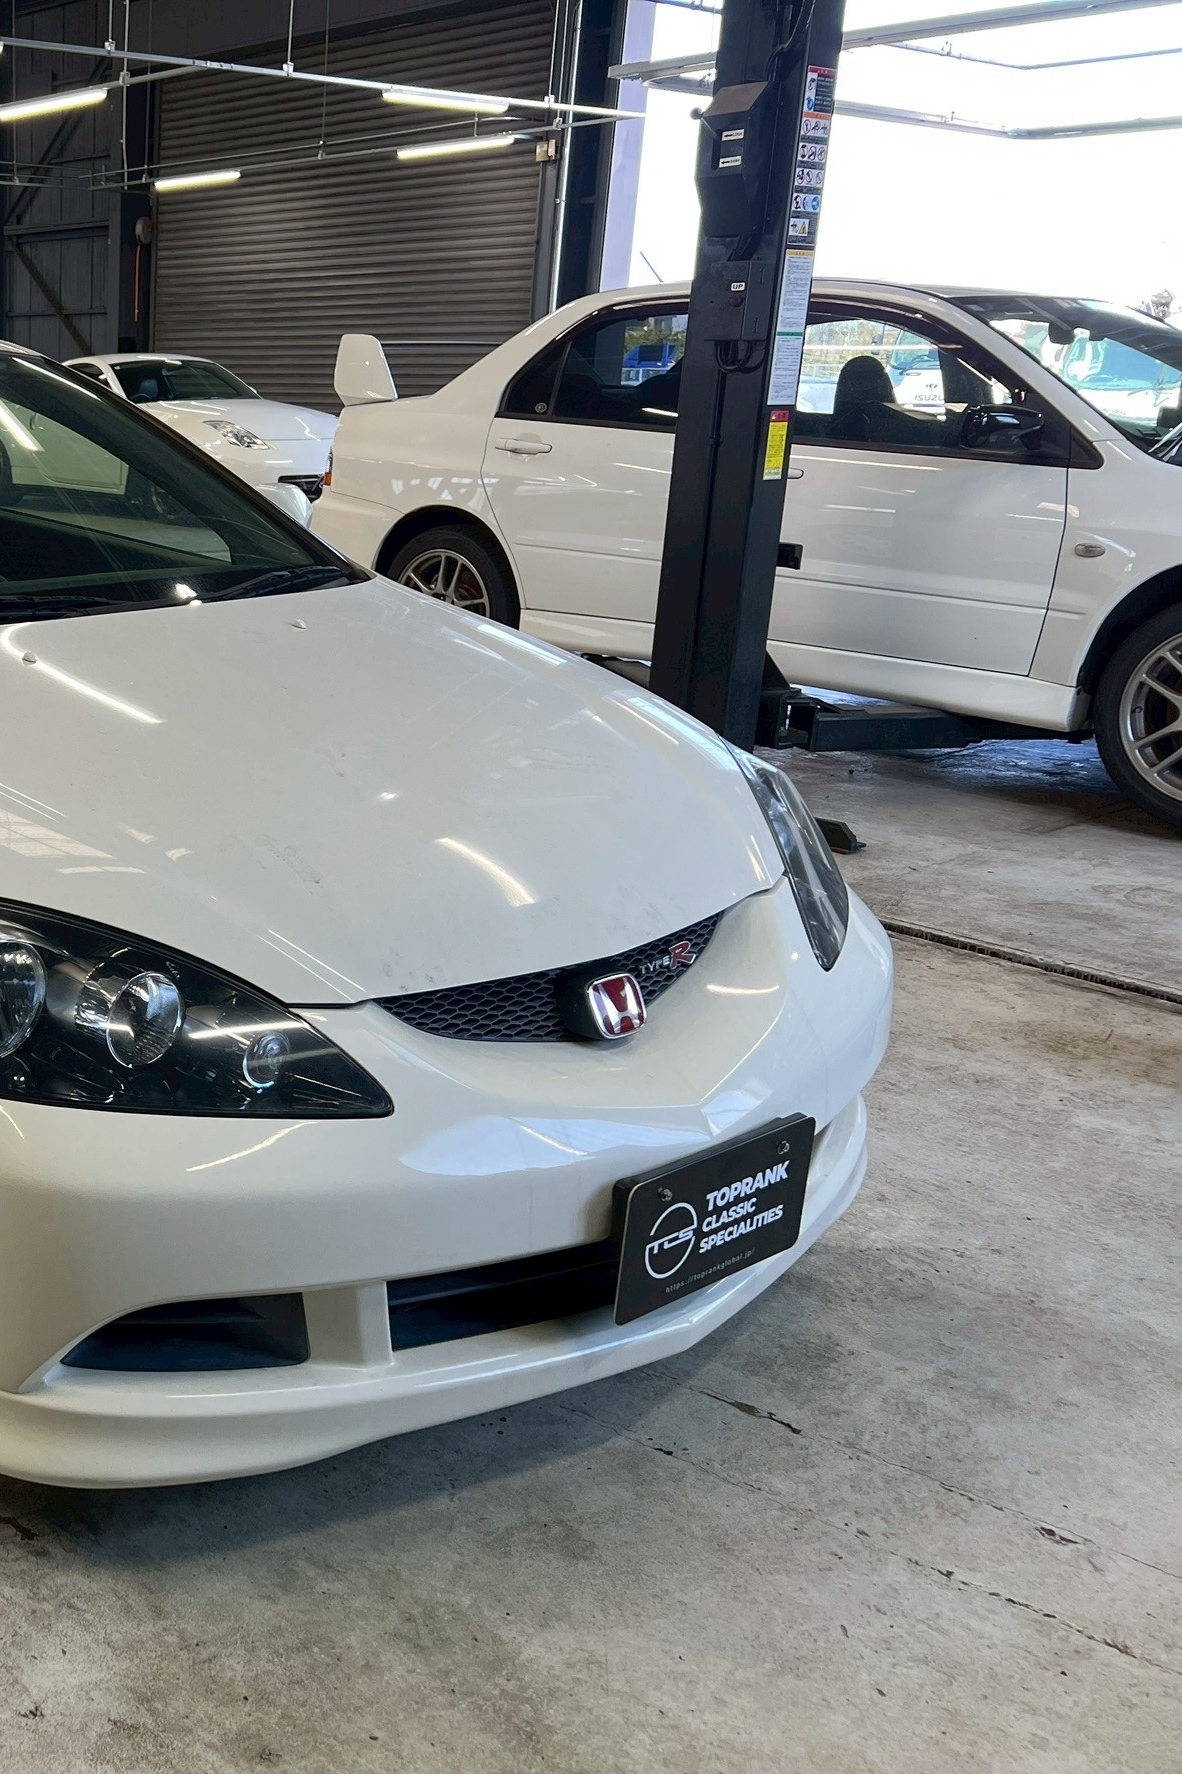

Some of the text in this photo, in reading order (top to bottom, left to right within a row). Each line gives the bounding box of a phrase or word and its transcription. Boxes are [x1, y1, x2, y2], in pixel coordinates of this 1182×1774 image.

[639, 940, 697, 974] TYPE R
[705, 1159, 791, 1212] TOPRANK
[698, 1203, 784, 1254] SPECIALITIES
[701, 1198, 758, 1233] CLASSIC
[647, 1225, 698, 1254] TCS
